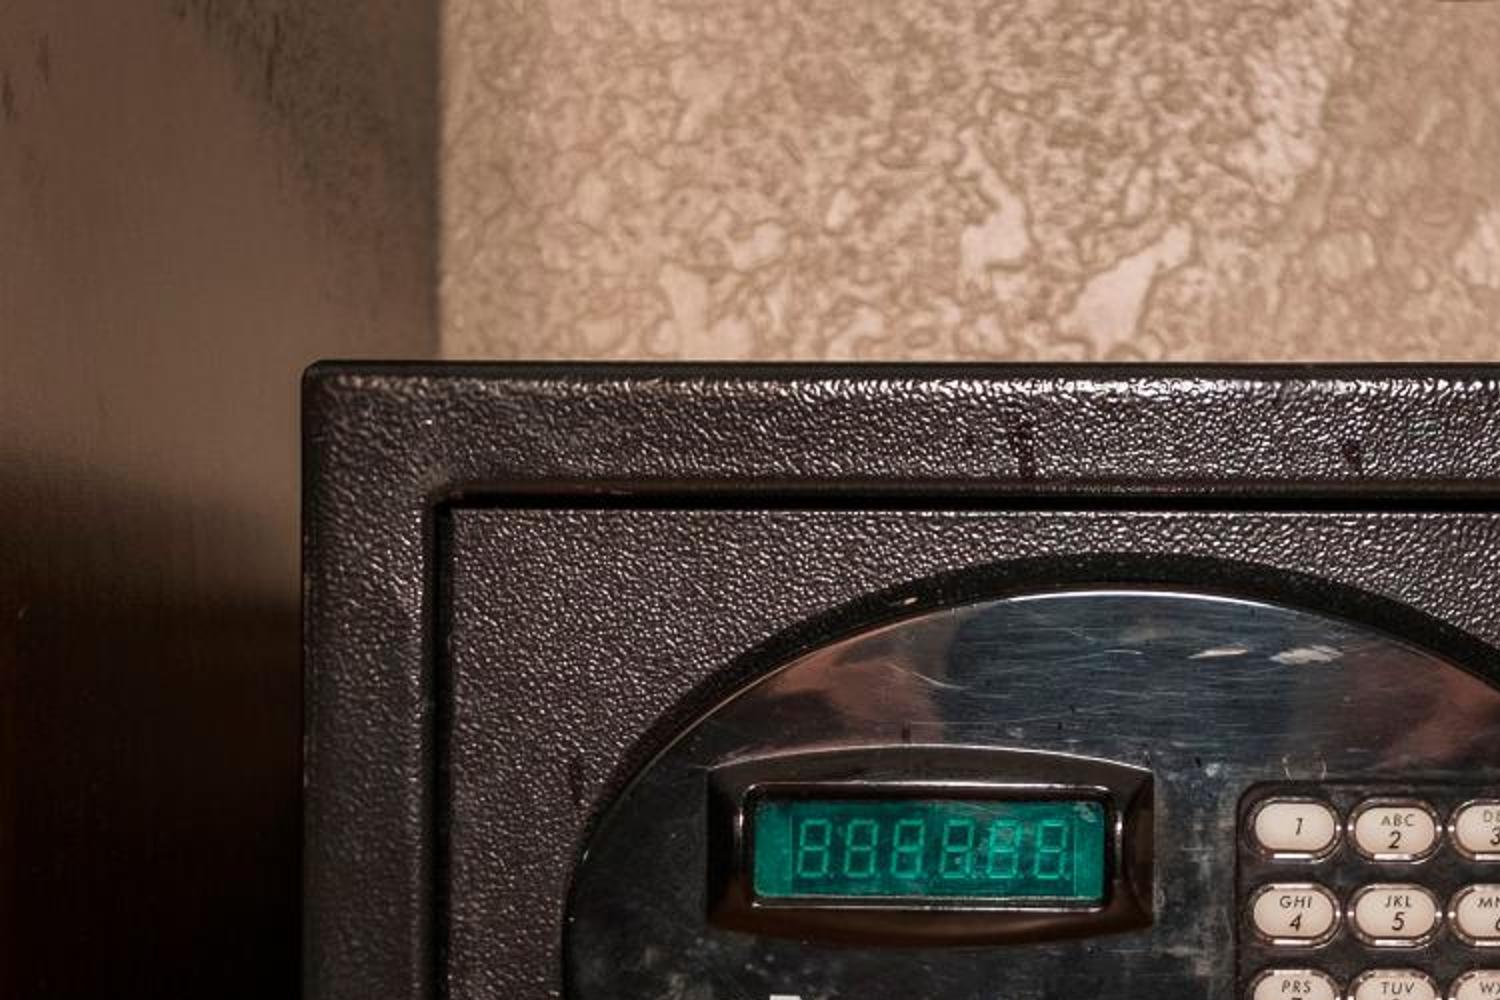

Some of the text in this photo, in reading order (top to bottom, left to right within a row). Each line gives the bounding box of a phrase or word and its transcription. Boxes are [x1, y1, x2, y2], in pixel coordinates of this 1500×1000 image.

[1295, 817, 1304, 836] 1
[1380, 813, 1416, 828] ABC
[1388, 830, 1402, 850] 2
[1279, 895, 1313, 910] GHI
[1384, 895, 1412, 909] JKL
[1289, 913, 1303, 933] 4
[1391, 911, 1406, 933] 5
[1281, 979, 1312, 994] PRS
[1381, 981, 1416, 996] TUV
